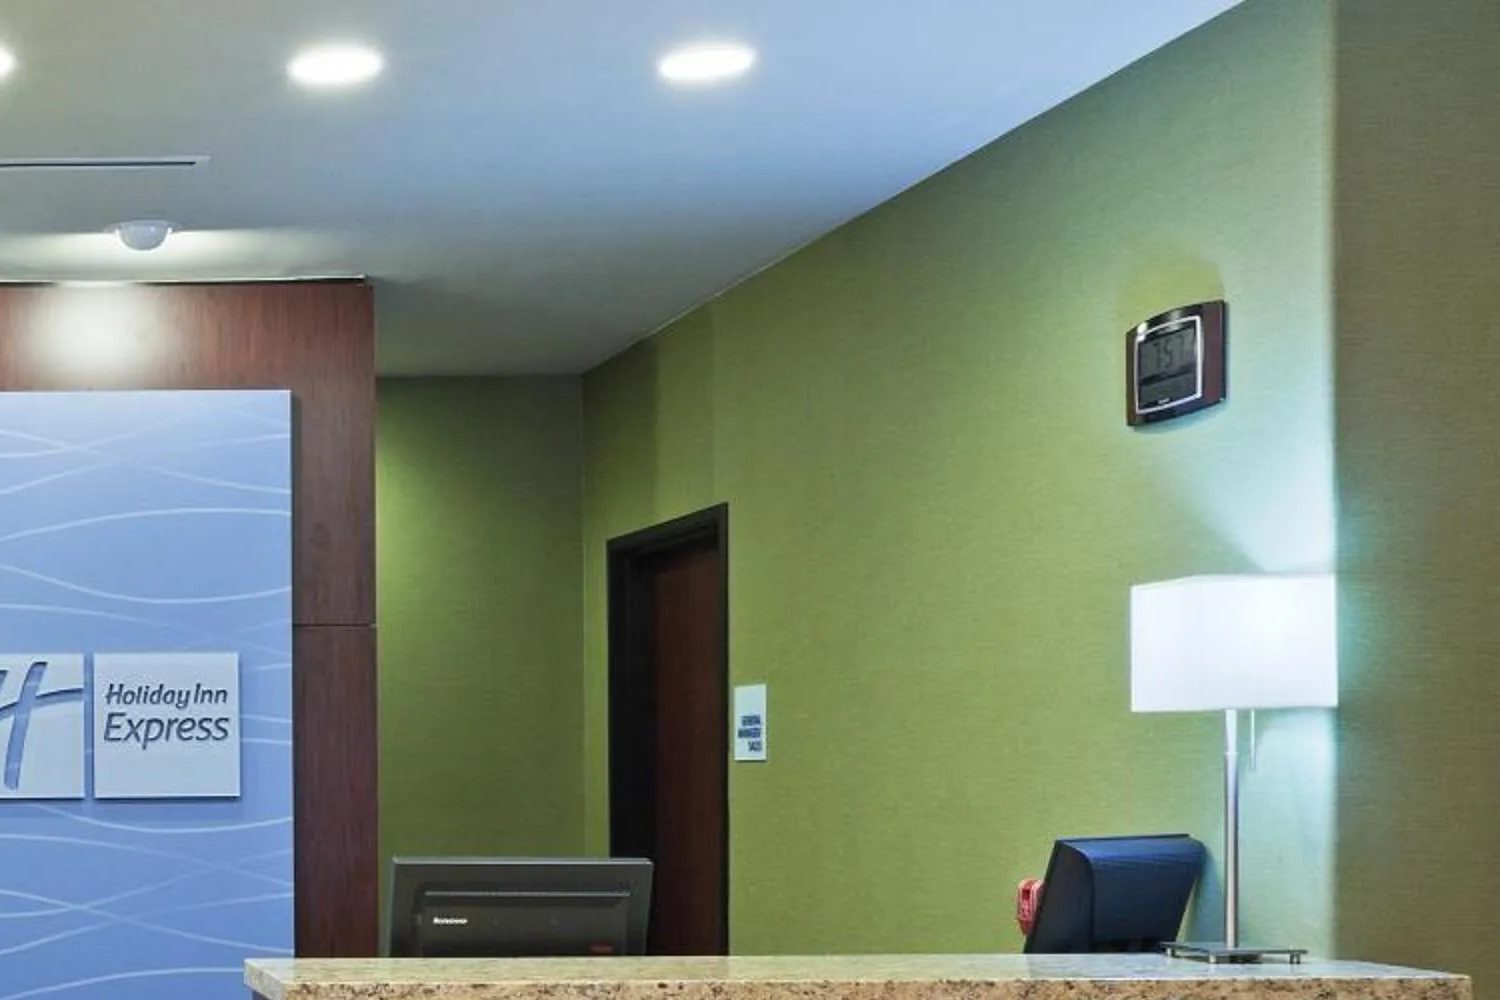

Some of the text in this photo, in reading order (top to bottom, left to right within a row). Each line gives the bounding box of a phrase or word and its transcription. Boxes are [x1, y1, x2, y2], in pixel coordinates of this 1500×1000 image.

[106, 683, 228, 709] Holiday Inn
[103, 711, 229, 750] Express
